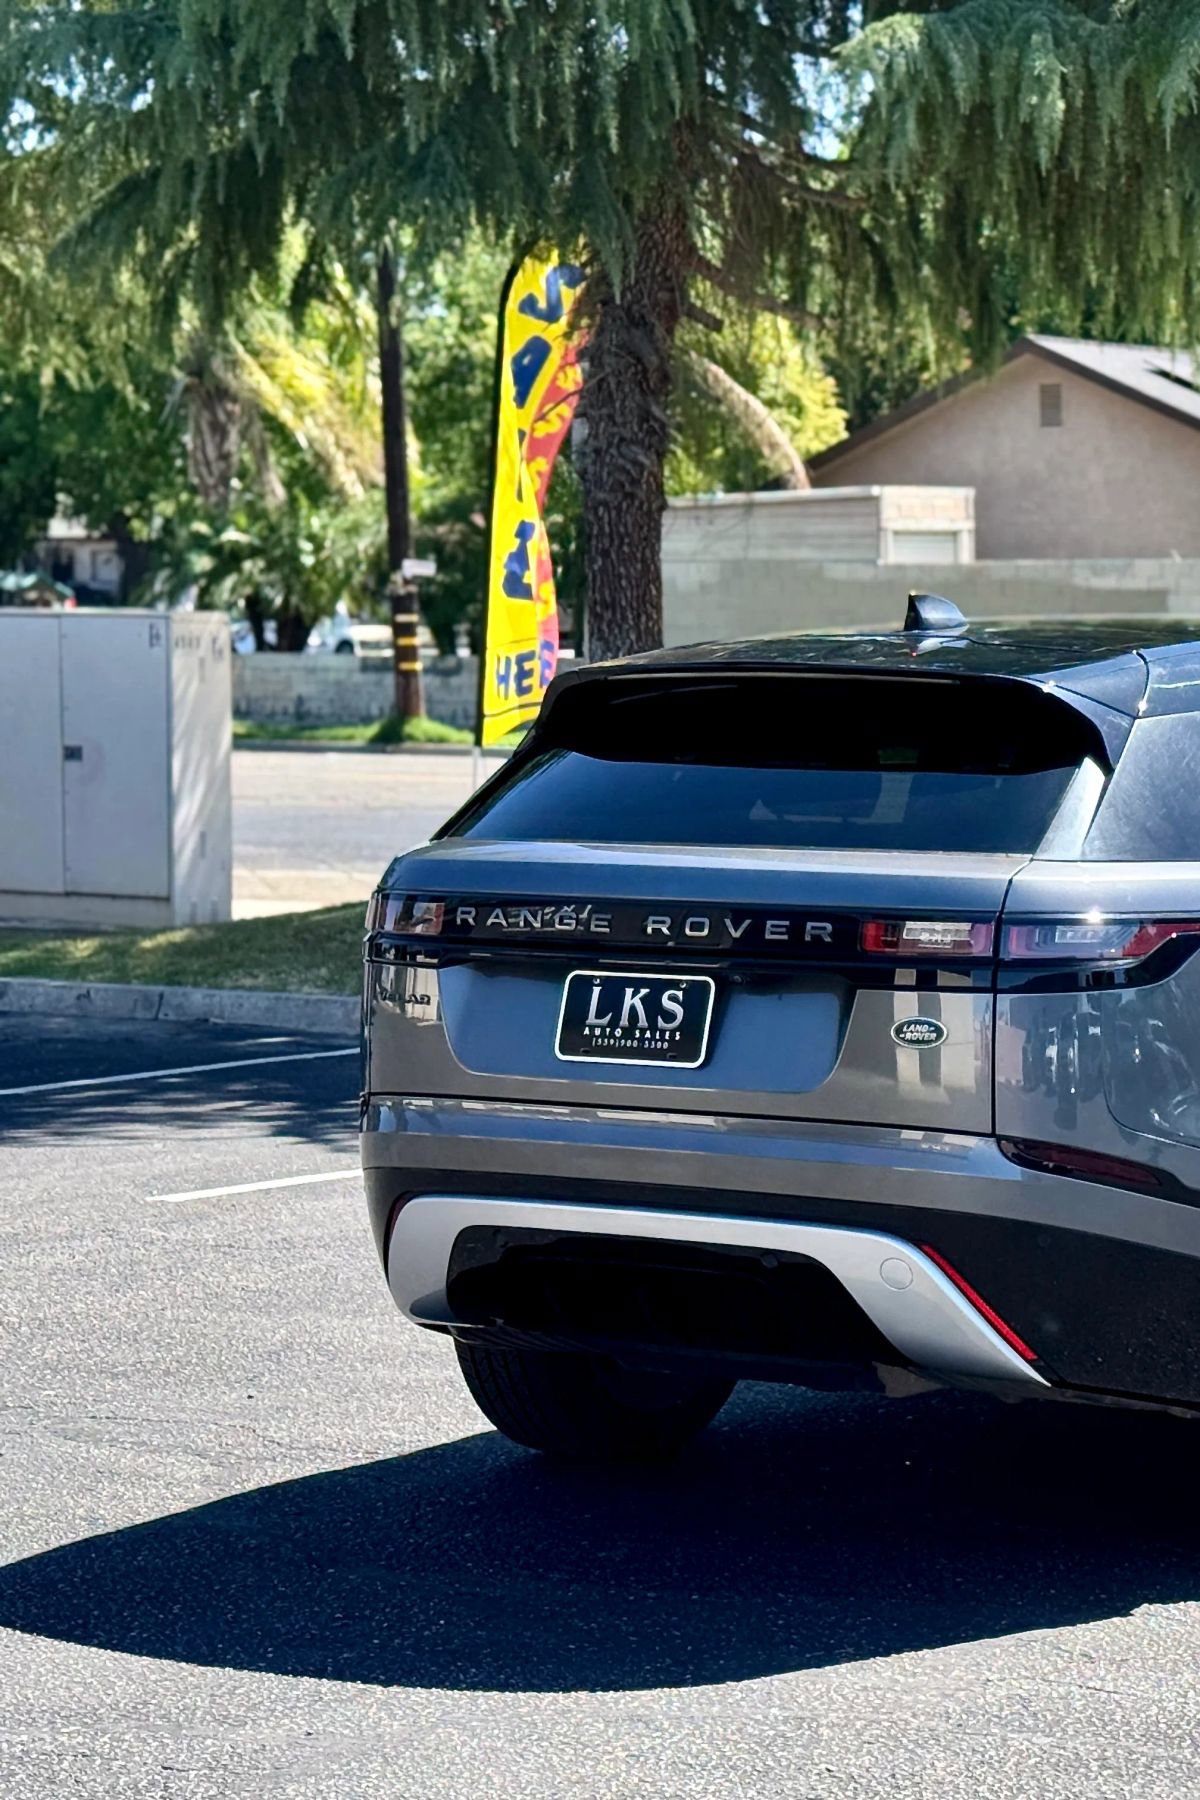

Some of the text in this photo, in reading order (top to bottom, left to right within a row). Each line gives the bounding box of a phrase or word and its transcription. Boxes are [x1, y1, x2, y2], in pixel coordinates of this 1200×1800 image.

[456, 906, 833, 943] RANGE ROVER
[585, 986, 684, 1030] LKS
[583, 1026, 681, 1041] AUTO SALES
